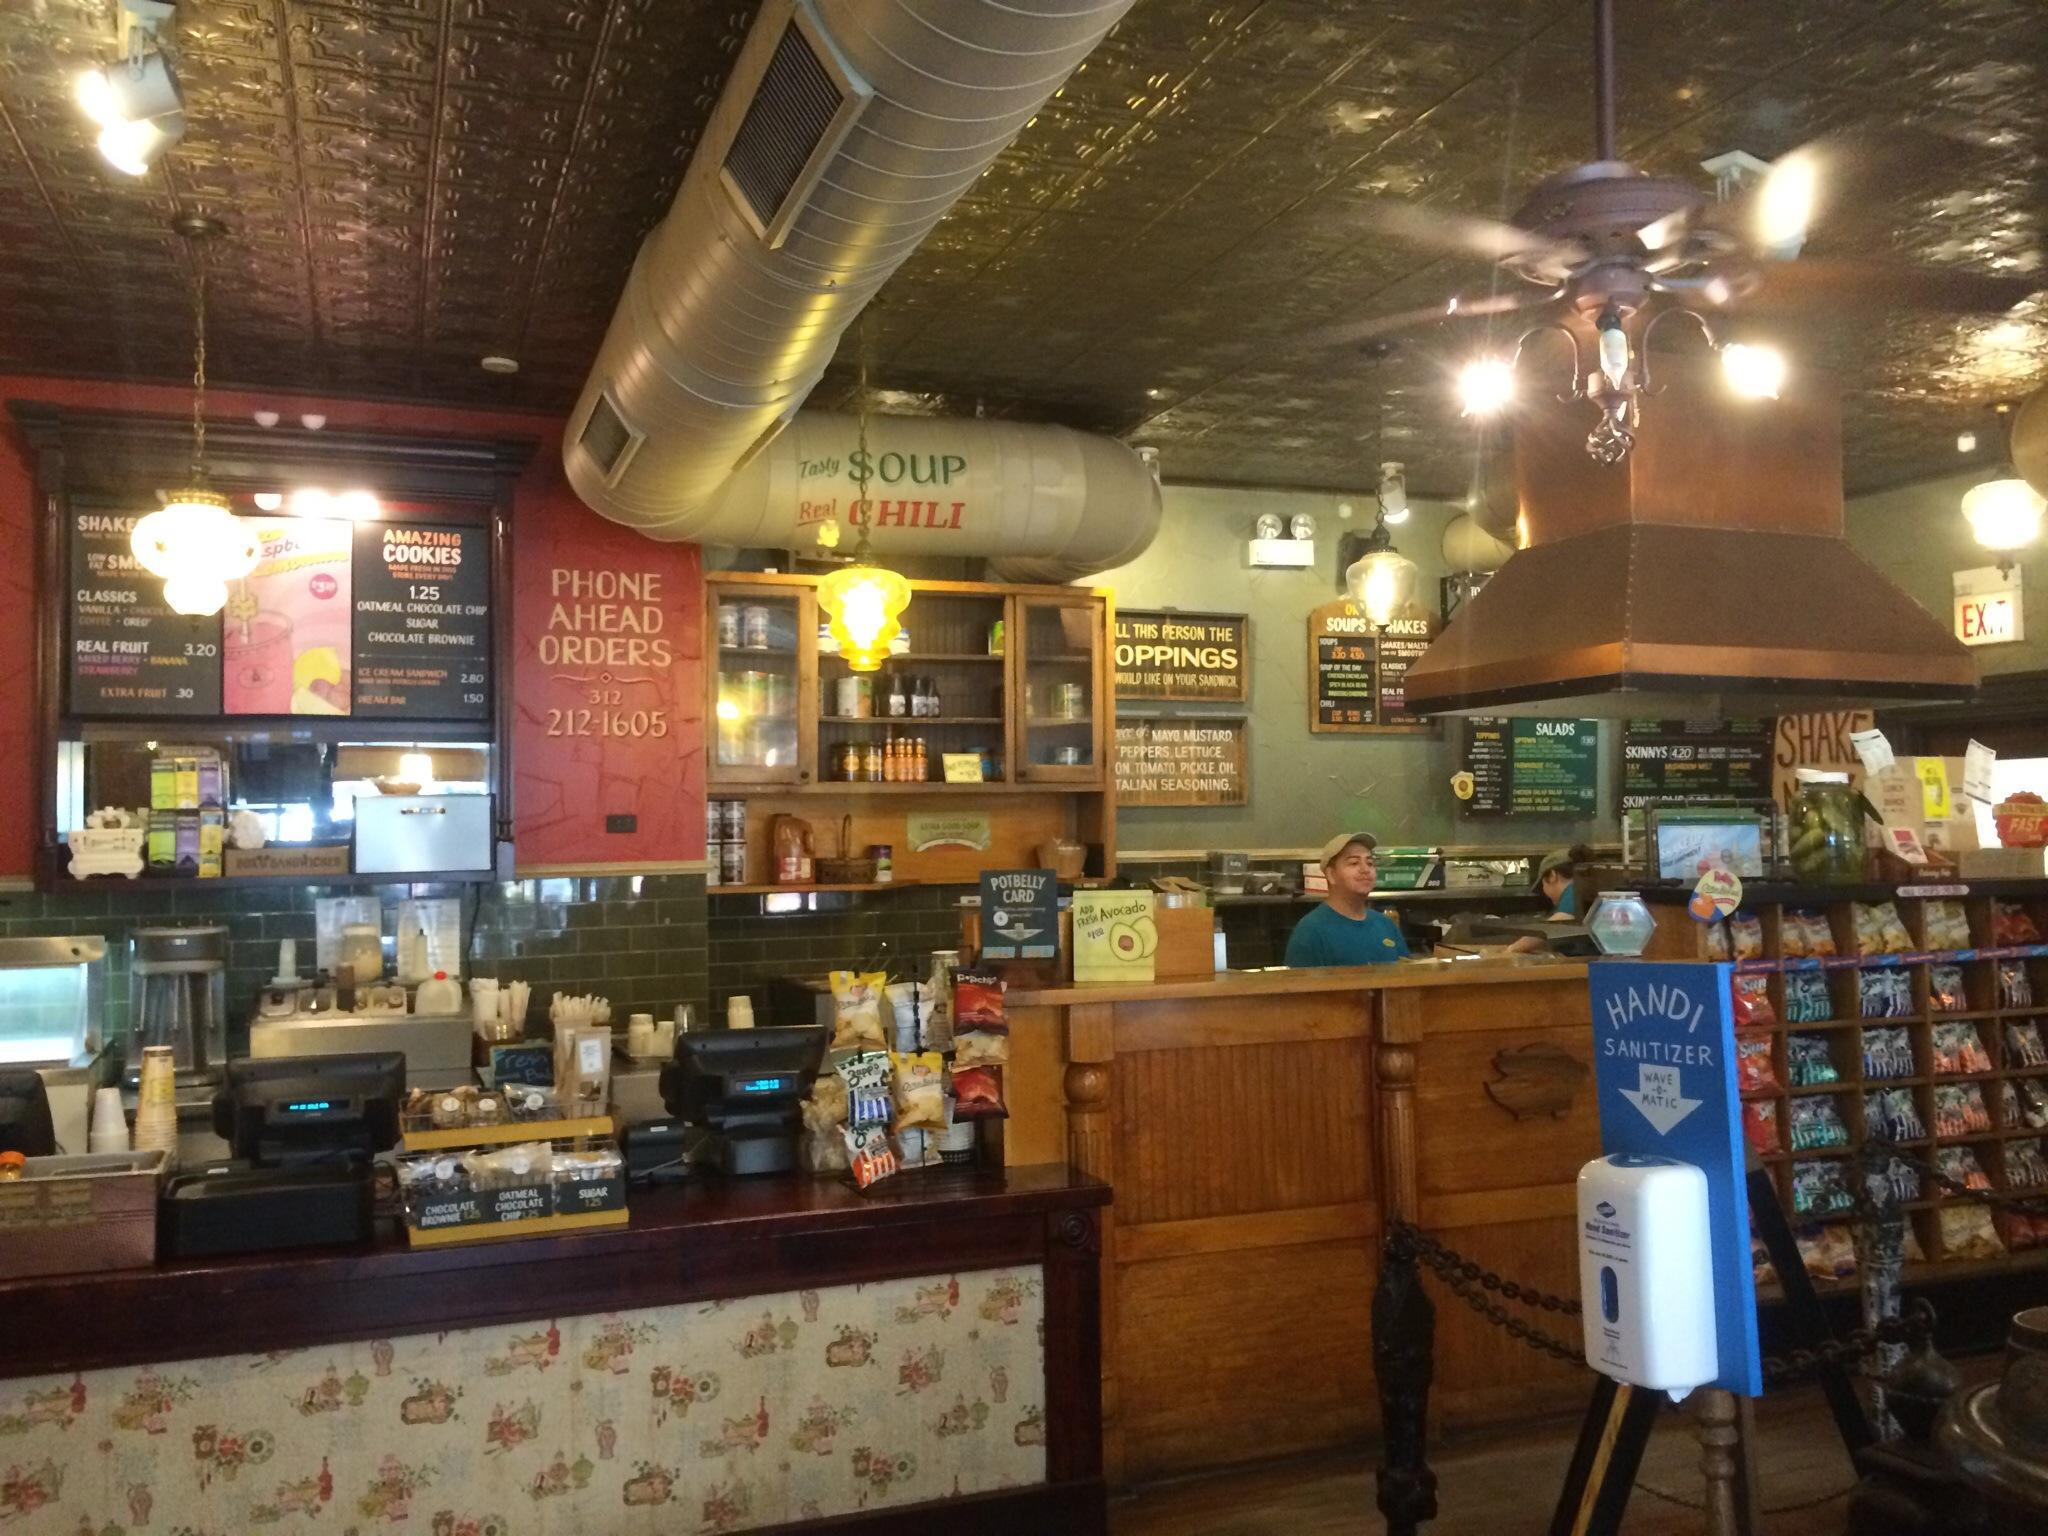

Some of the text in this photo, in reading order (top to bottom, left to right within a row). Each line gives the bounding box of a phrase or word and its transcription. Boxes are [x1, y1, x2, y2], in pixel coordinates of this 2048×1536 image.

[800, 451, 967, 485] Tasty SOUP
[800, 499, 966, 530] Real CHILI
[383, 529, 462, 546] AMAZING
[383, 544, 462, 565] COOKIES
[409, 585, 440, 600] 1.25
[552, 569, 662, 602] PHONE
[77, 589, 137, 603] CLASSICS
[79, 605, 120, 614] VANILLA
[357, 601, 488, 616] OATMEAL CHOCOLATE CHIP
[406, 618, 438, 629] SUGAR
[548, 603, 664, 634] AHEAD
[1326, 617, 1366, 632] SOUPS
[1962, 601, 2006, 638] EXT
[368, 632, 475, 645] CHOCOLATE BROWNIE
[1133, 624, 1157, 639] THIS
[1162, 625, 1205, 641] PERSON
[1209, 627, 1233, 642] THE
[77, 640, 216, 657] REAL FRUIT 3.20
[539, 635, 672, 668] ORDERS
[460, 674, 484, 684] 2.80
[1144, 672, 1161, 685] LIKE
[1163, 673, 1173, 685] ON
[1175, 673, 1197, 686] YOUR
[101, 688, 134, 697] EXTRA
[138, 688, 167, 698] FRUIT
[463, 694, 484, 703] 1.50
[590, 690, 622, 705] 312
[547, 708, 668, 737] 212-1605
[1536, 723, 1575, 736] SALADS
[1625, 746, 1667, 759] SKINNYS
[2009, 818, 2043, 833] FAST
[991, 874, 1046, 890] POTBELLY
[1003, 889, 1034, 903] CARD
[1080, 905, 1094, 915] ADD
[1101, 900, 1146, 921] Avocado
[1077, 914, 1098, 928] FRESH
[1606, 983, 1704, 1033] HANDI
[1604, 1038, 1714, 1066] SANITIZER
[1643, 1073, 1673, 1085] WAVE
[1641, 1096, 1678, 1110] MATIC
[500, 1189, 538, 1201] OATMEAL
[579, 1187, 608, 1199] SUGAR
[425, 1201, 475, 1214] CHOCOLATE
[495, 1198, 544, 1211] CHOCOLATE
[501, 1210, 521, 1221] CHIP
